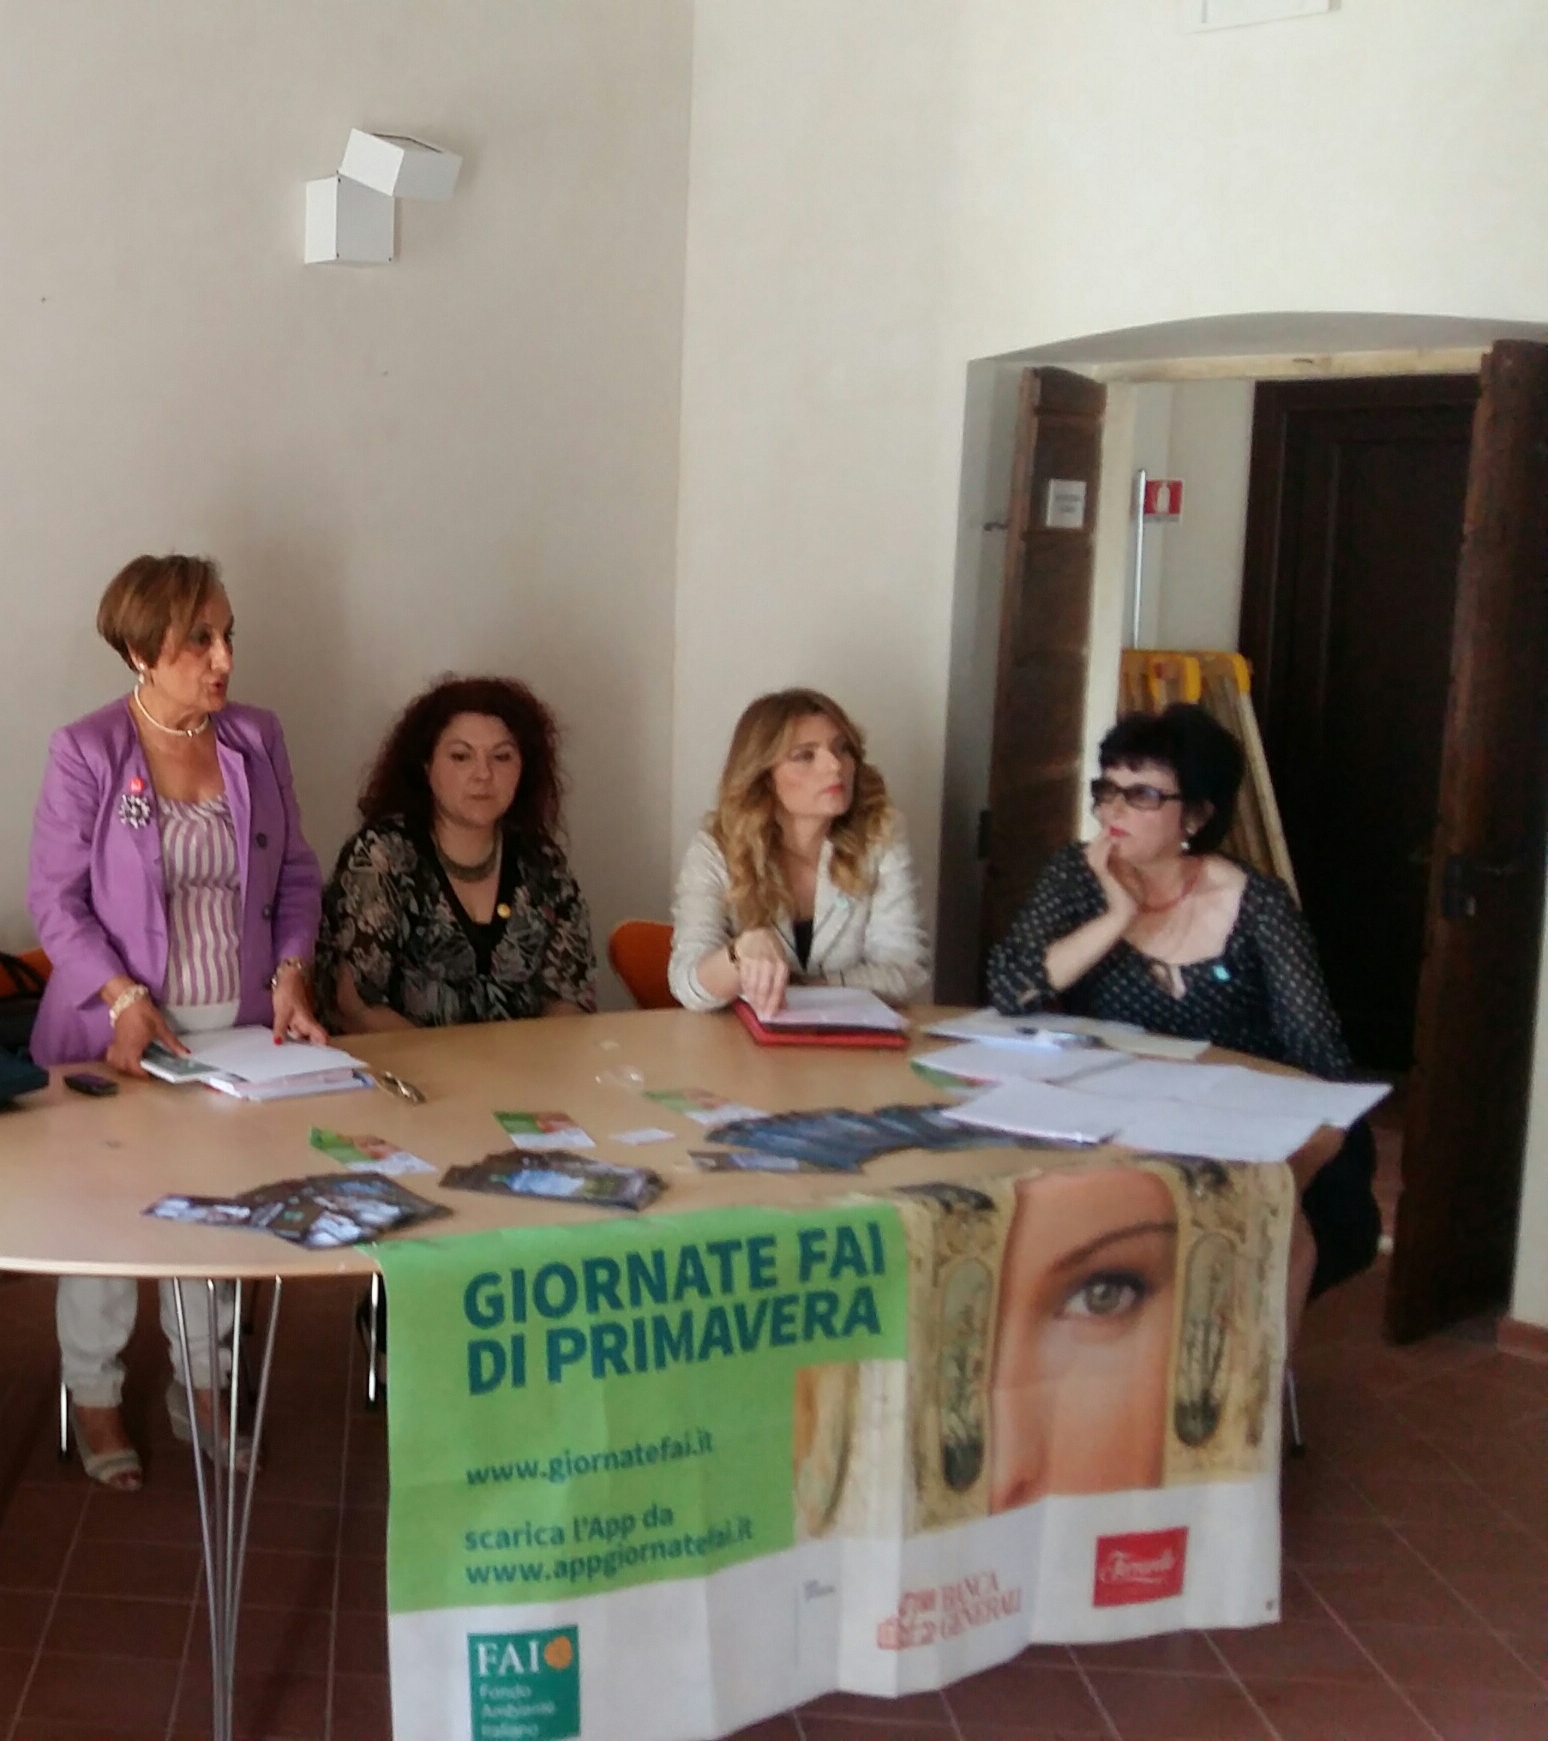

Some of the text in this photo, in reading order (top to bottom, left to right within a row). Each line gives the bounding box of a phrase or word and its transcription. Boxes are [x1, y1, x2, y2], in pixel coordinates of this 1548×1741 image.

[463, 1221, 887, 1330] GIORNATE FAI
[466, 1285, 883, 1396] DI PRIMAVERA
[465, 1427, 714, 1487] www.giornatefai.it
[464, 1503, 675, 1552] scarica l'App da
[465, 1515, 754, 1585] www.appgiornatefai.it
[477, 1639, 540, 1679] FAI
